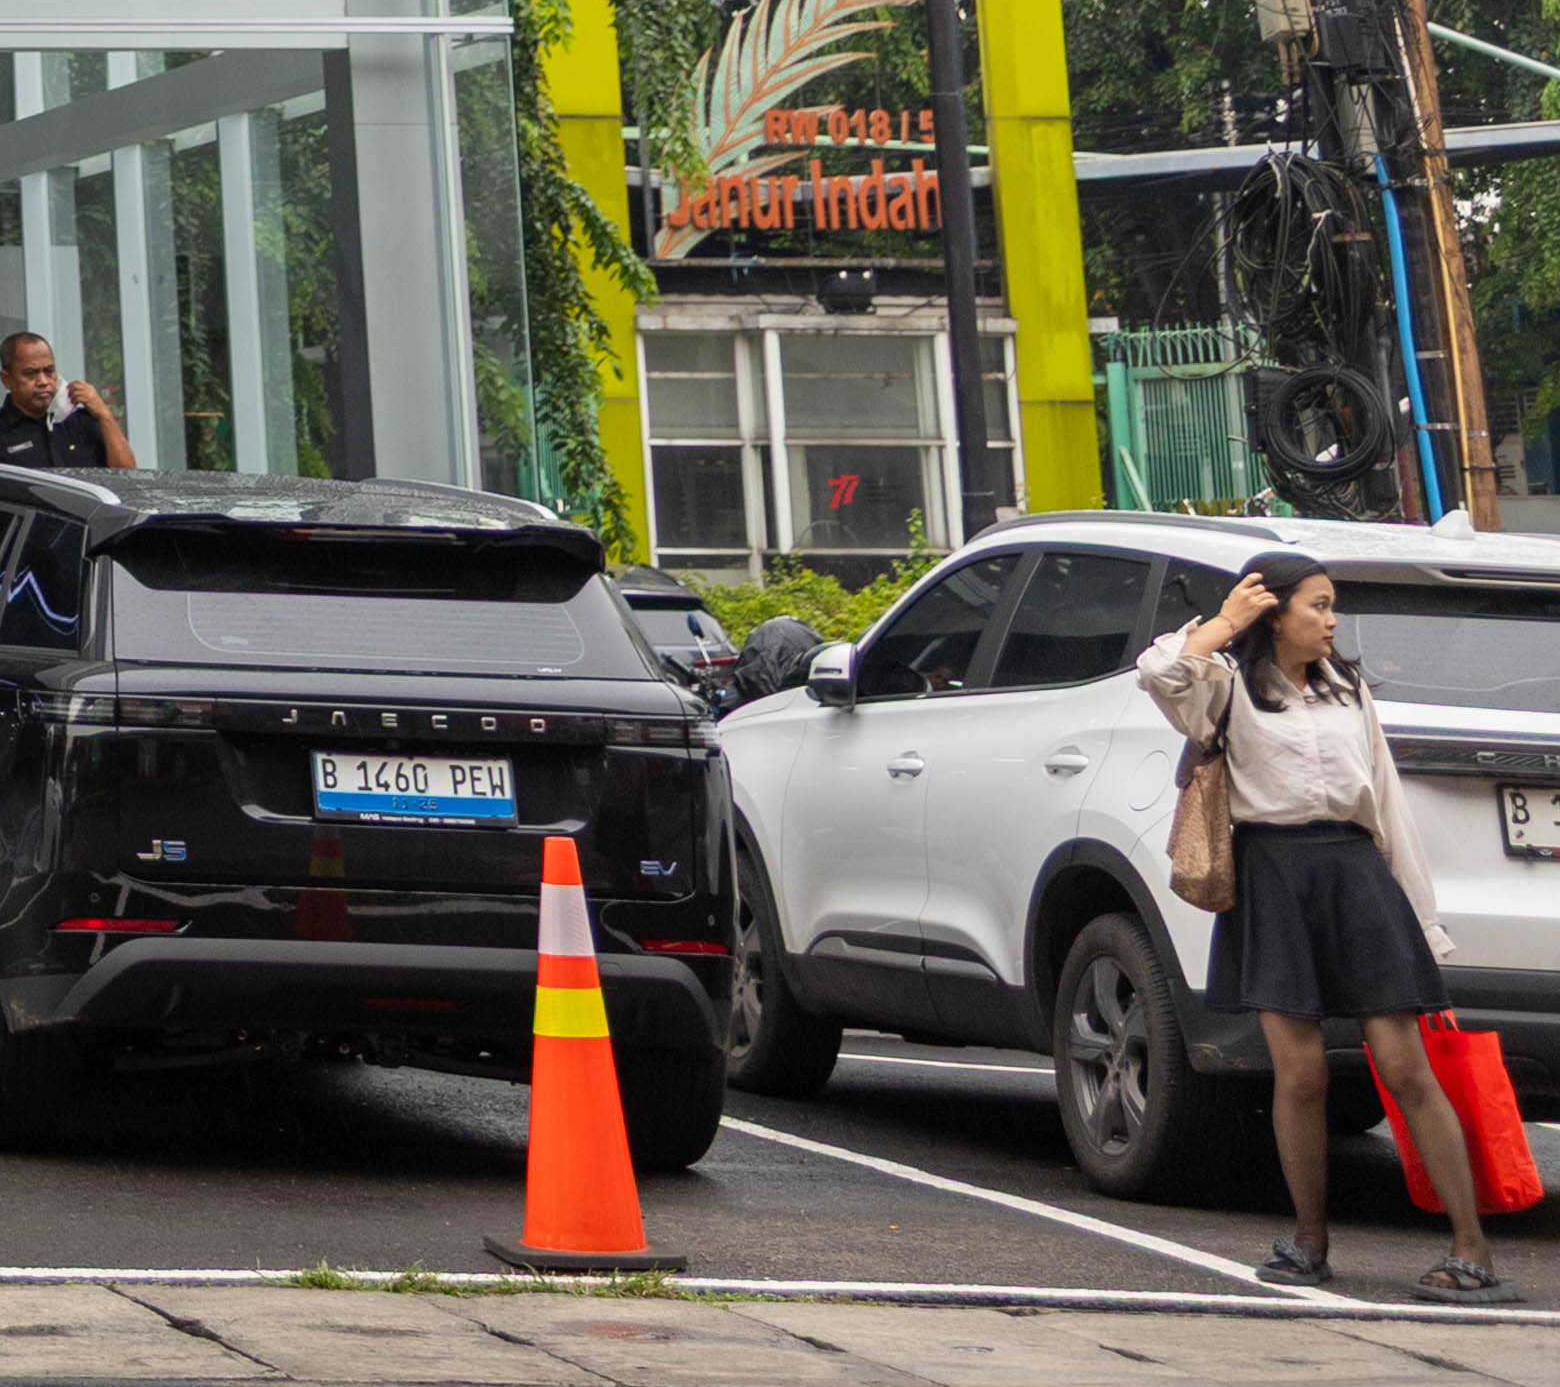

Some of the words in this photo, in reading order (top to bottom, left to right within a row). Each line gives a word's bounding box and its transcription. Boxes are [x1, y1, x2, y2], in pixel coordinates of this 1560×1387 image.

[764, 109, 818, 145] RW
[828, 108, 891, 145] 018
[810, 158, 942, 230] Indah
[282, 708, 546, 733] JAECOO
[321, 758, 338, 789] B
[356, 761, 428, 793] 1460
[450, 764, 506, 797] PEW
[1509, 791, 1531, 825] B
[640, 859, 678, 877] EV
